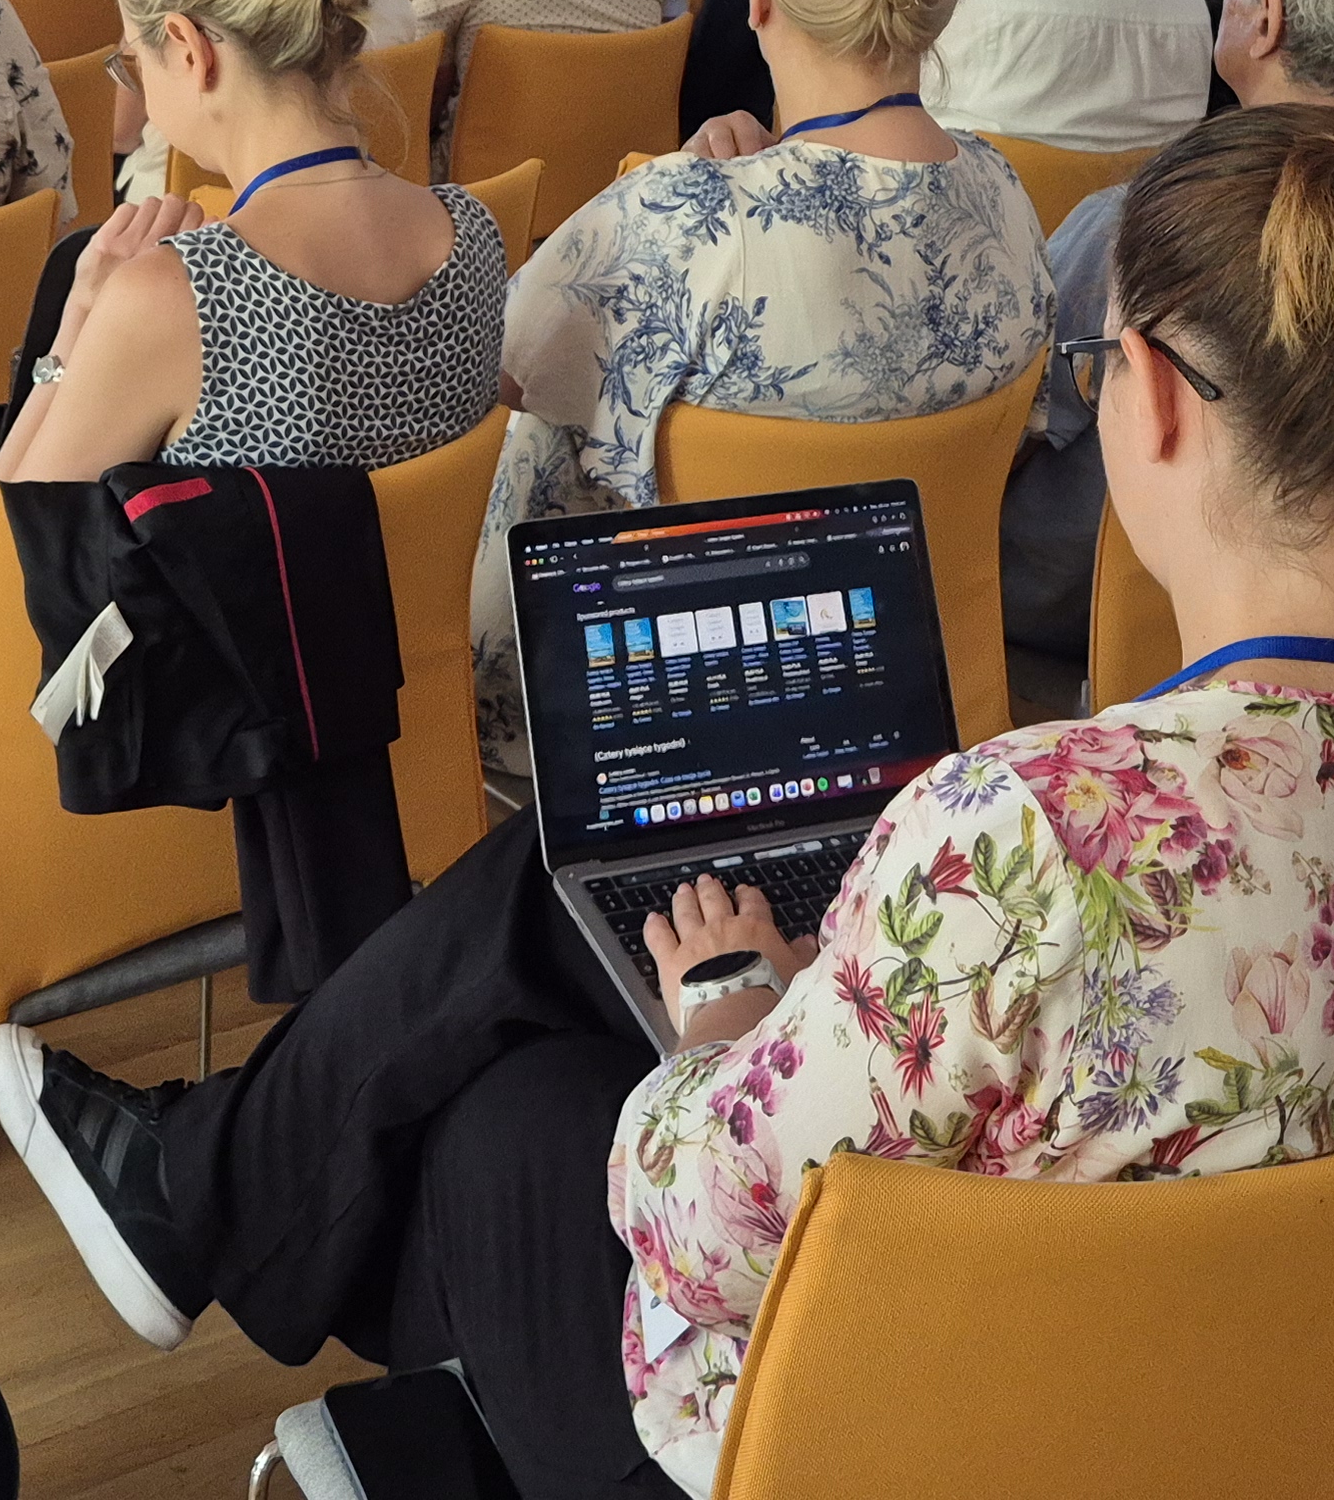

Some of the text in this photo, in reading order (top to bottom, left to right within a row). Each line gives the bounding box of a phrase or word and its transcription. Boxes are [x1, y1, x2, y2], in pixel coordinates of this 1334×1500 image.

[573, 581, 601, 594] Google
[576, 606, 636, 622] Sponsored products
